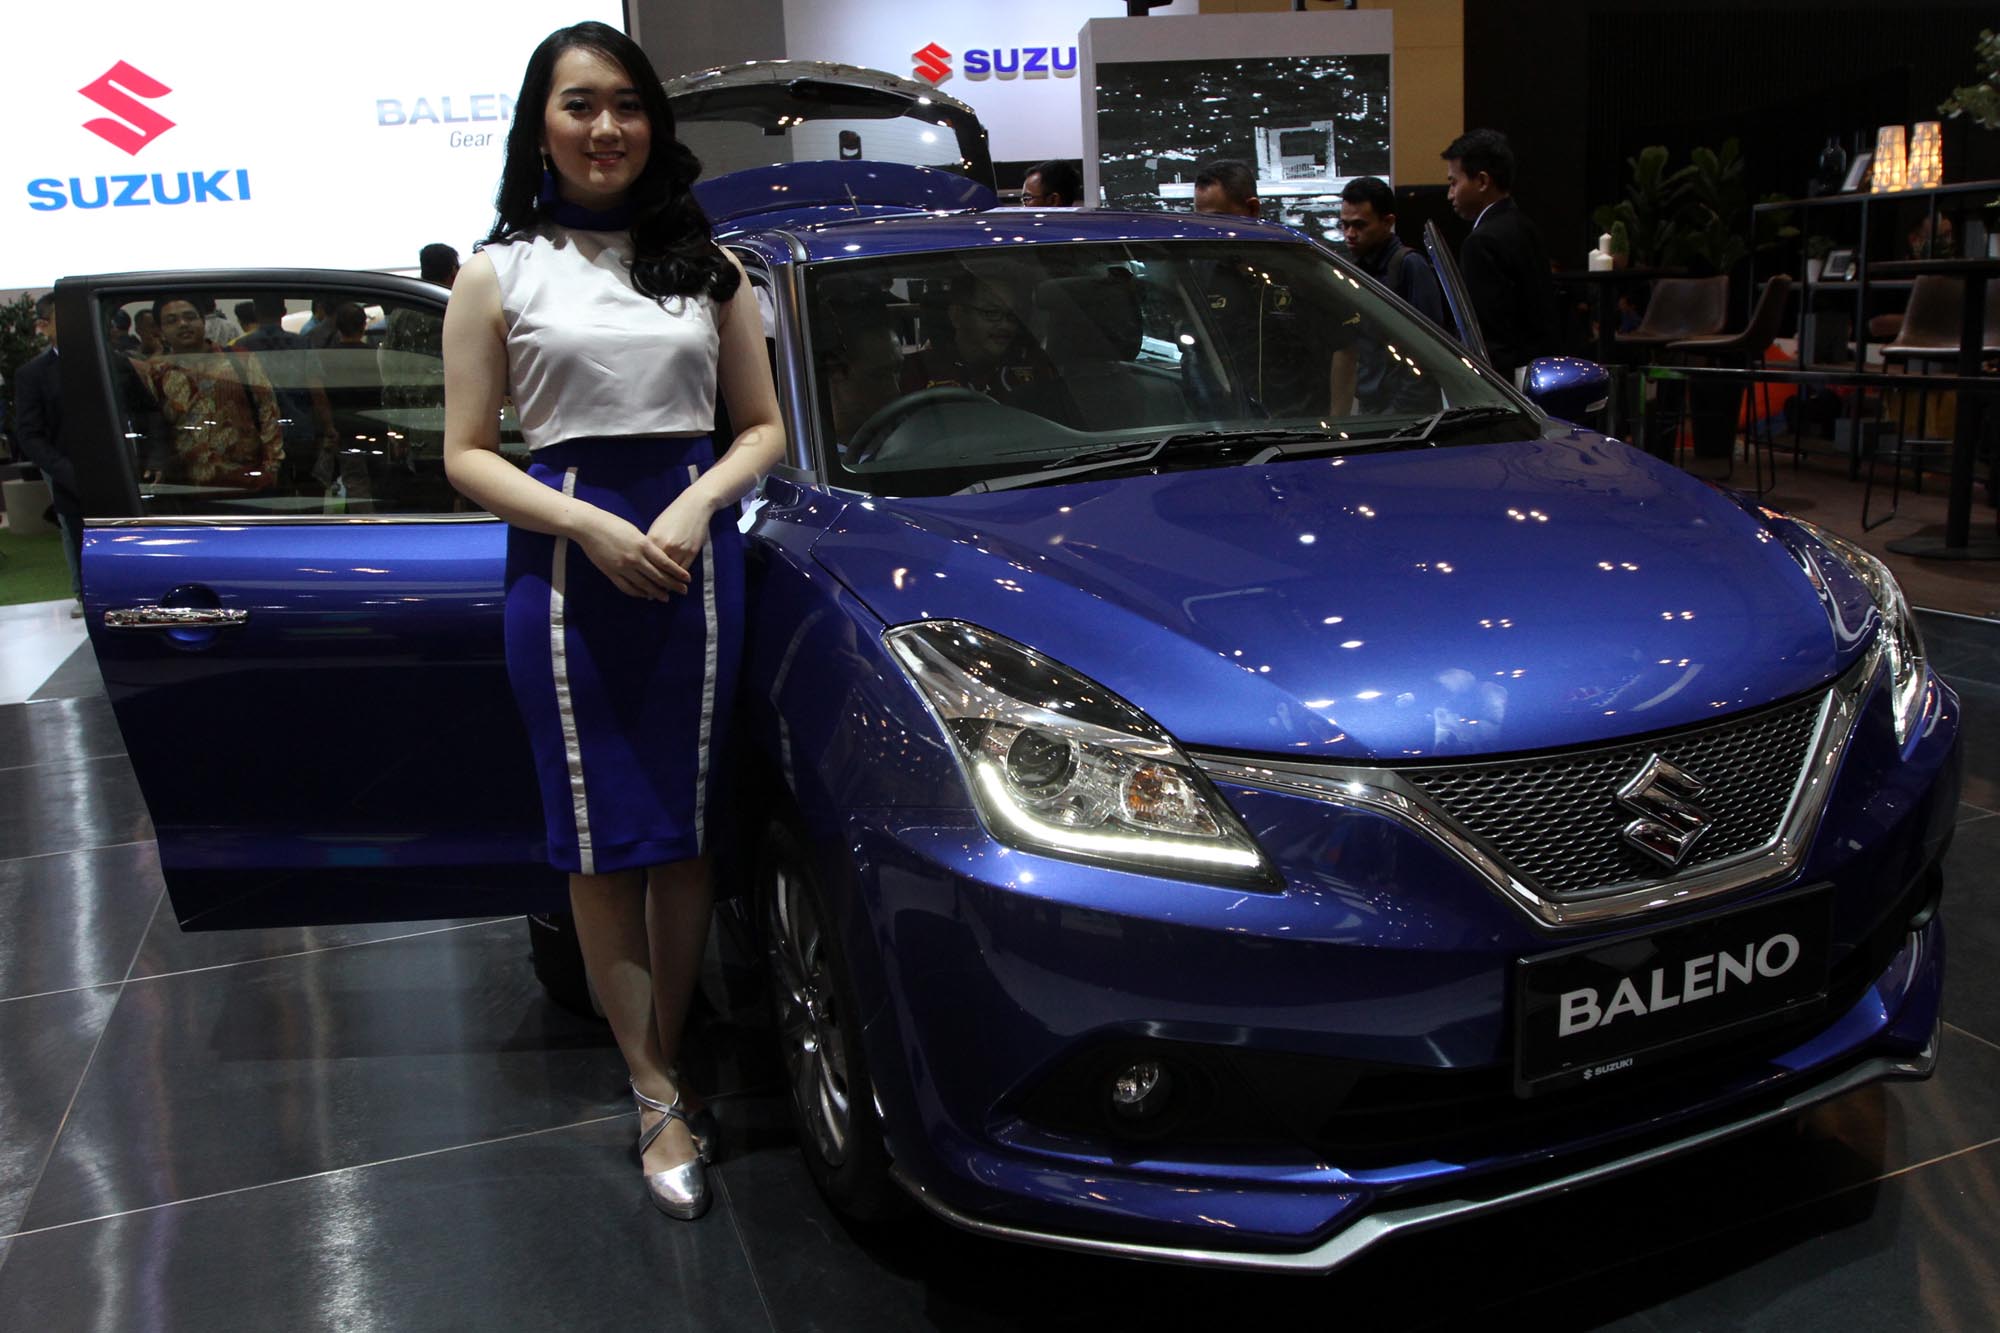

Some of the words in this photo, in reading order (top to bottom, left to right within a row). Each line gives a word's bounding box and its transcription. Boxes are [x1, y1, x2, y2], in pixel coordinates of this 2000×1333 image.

[963, 46, 1077, 77] SUZU
[450, 130, 493, 148] Gear
[26, 168, 251, 211] SUZUKI
[1558, 933, 1800, 1038] BALENO
[1594, 1058, 1633, 1076] SUZUKI
